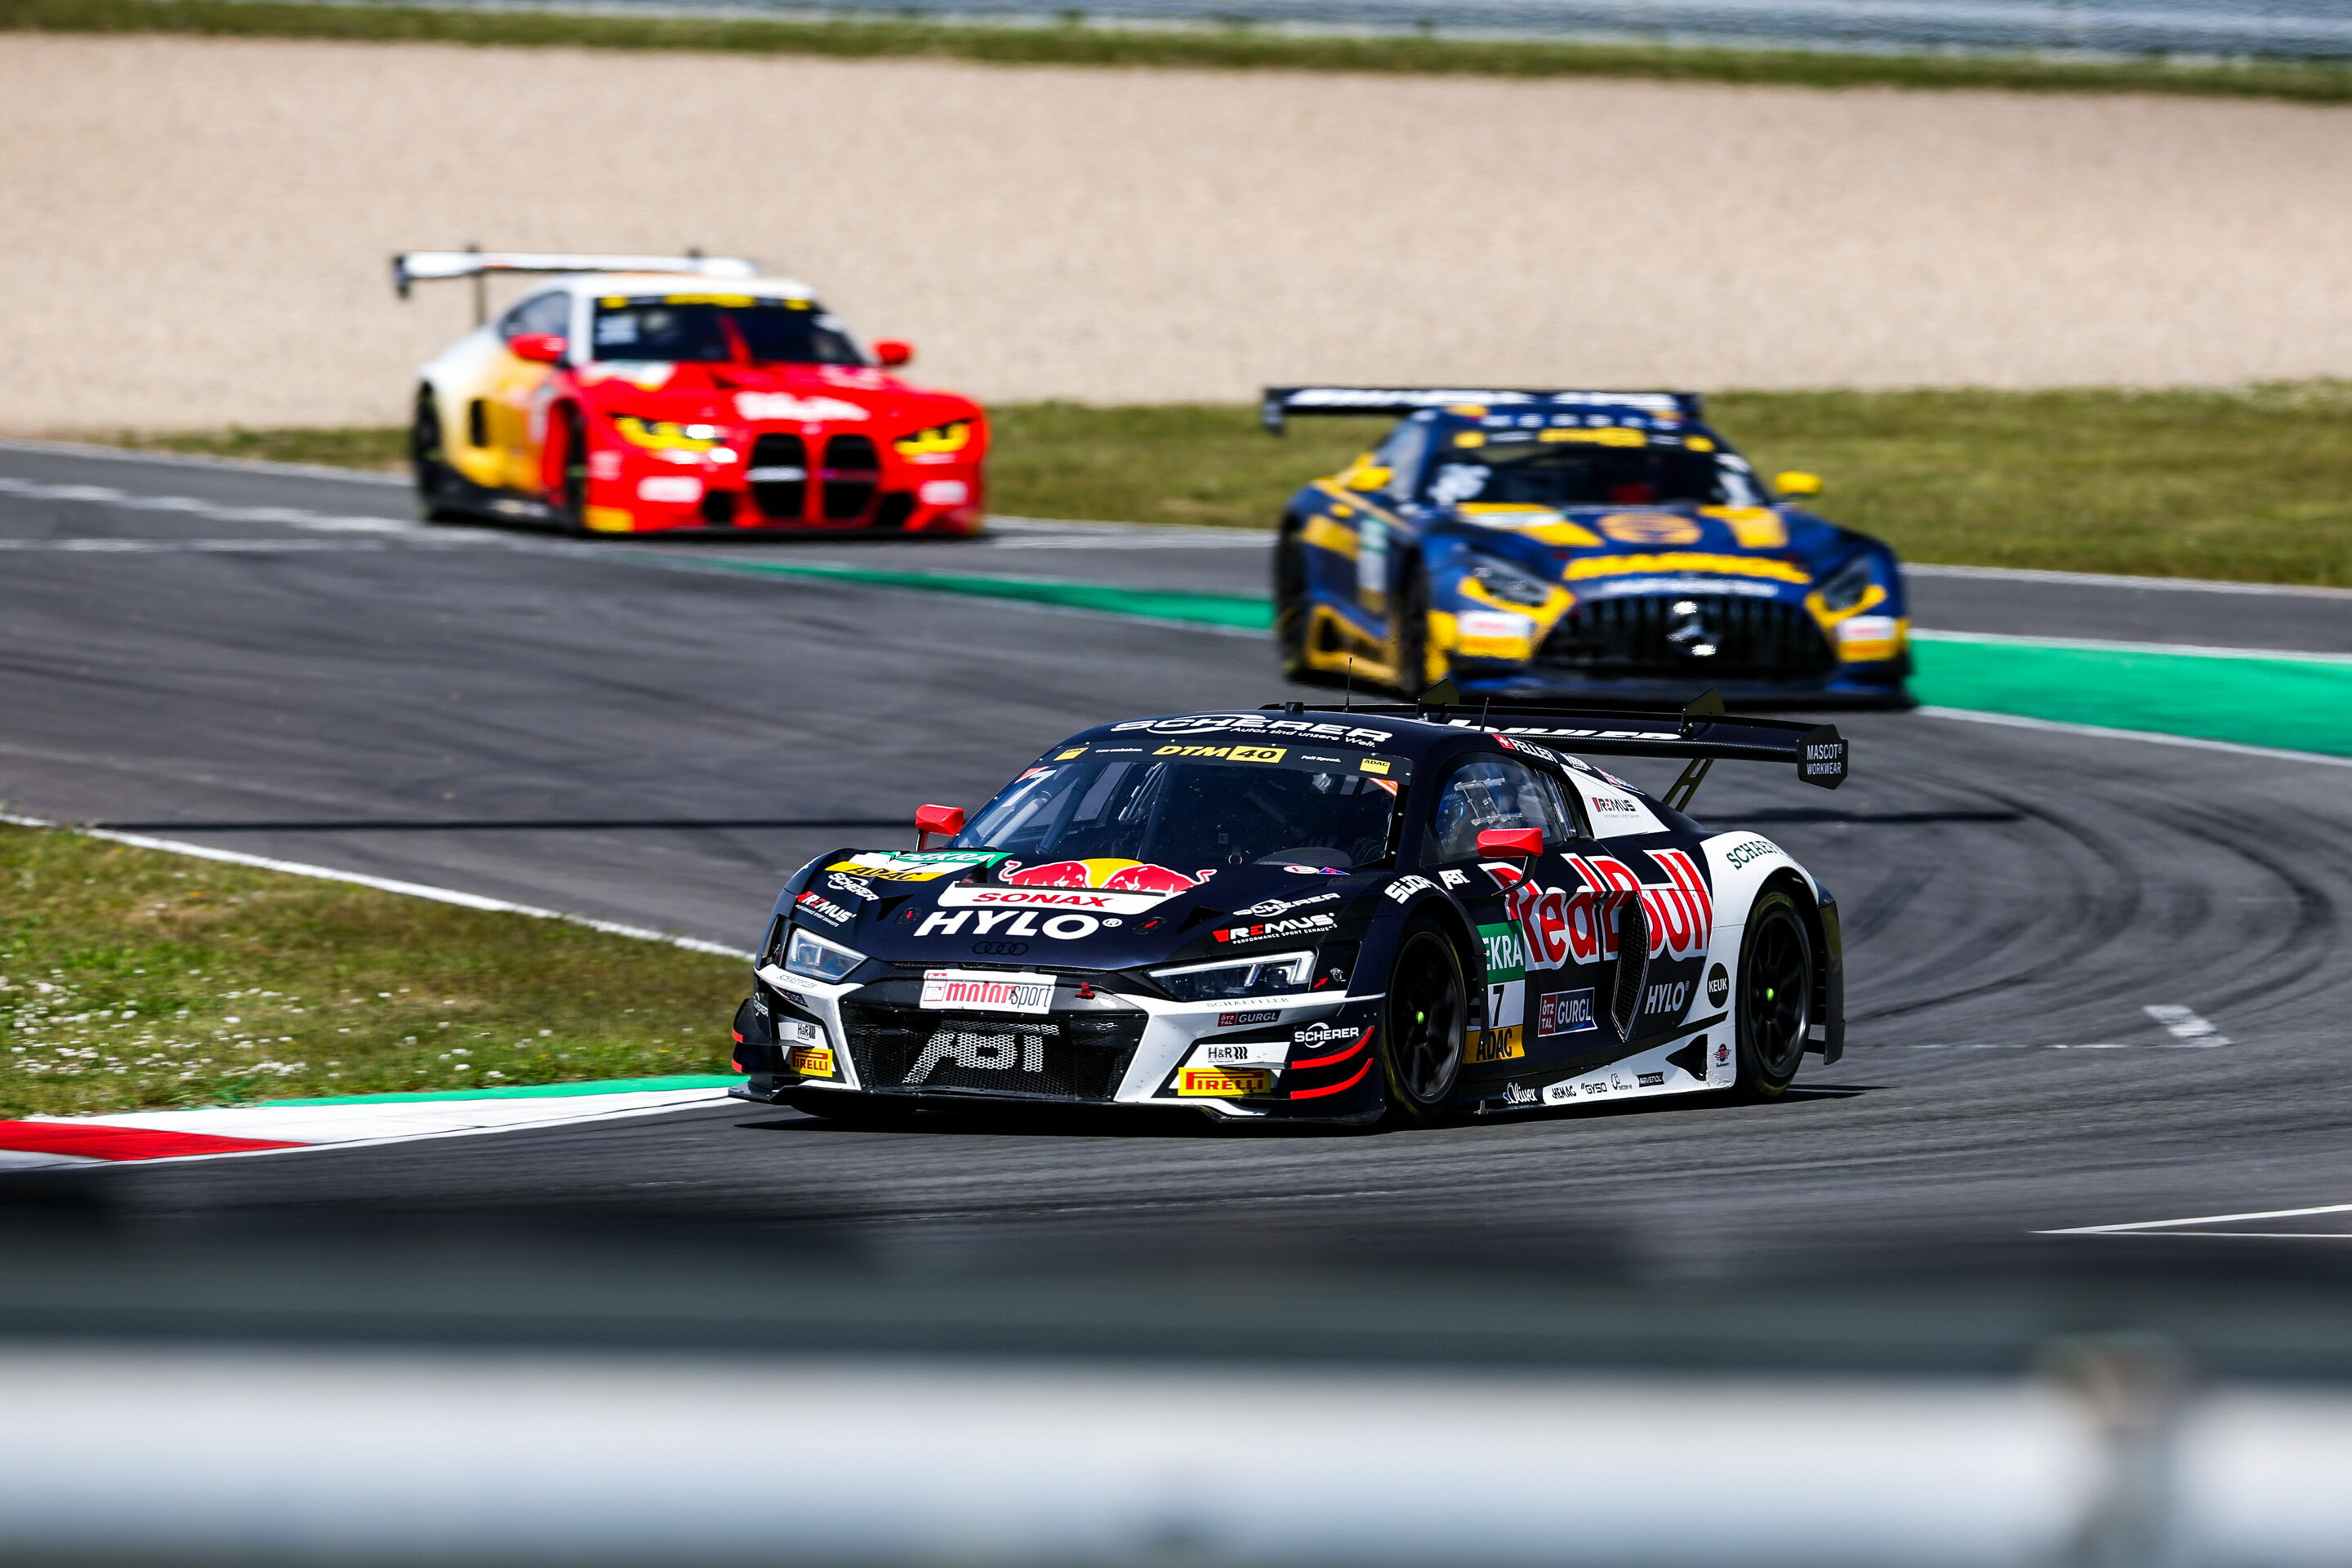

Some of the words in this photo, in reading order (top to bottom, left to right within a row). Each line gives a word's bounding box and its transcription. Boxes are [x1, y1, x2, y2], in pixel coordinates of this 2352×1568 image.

[1111, 718, 1393, 742] SCHERER
[1298, 732, 1339, 741] unsere
[1152, 746, 1232, 757] DTM
[1236, 749, 1277, 760] 40
[1508, 737, 1558, 764] FELLER
[1806, 762, 1842, 775] WORKWEAR
[1599, 798, 1636, 811] REMUS
[846, 867, 923, 880] ADAC
[1438, 869, 1471, 889] ABT
[828, 872, 880, 902] SCHERER
[973, 893, 1114, 907] SONAX
[1232, 893, 1341, 915] SCHERER
[802, 893, 854, 924] REMUS
[1230, 914, 1335, 940] REMUS
[1232, 933, 1280, 944] PERFORMANCE
[1481, 933, 1524, 970] EKRA
[1708, 978, 1727, 993] KEUK
[1206, 997, 1290, 1008] SCHAEFFLER
[1493, 984, 1505, 1027] 7
[1542, 1000, 1554, 1015] ÖTZ
[1238, 1012, 1277, 1023] GURGL
[1557, 999, 1592, 1025] GURGL
[1542, 1018, 1552, 1029] TAL
[1294, 1027, 1359, 1043] SCHERER
[792, 1049, 828, 1071] PIRELLI
[1208, 1046, 1232, 1059] H&R
[1186, 1071, 1265, 1090] PIRELLI
